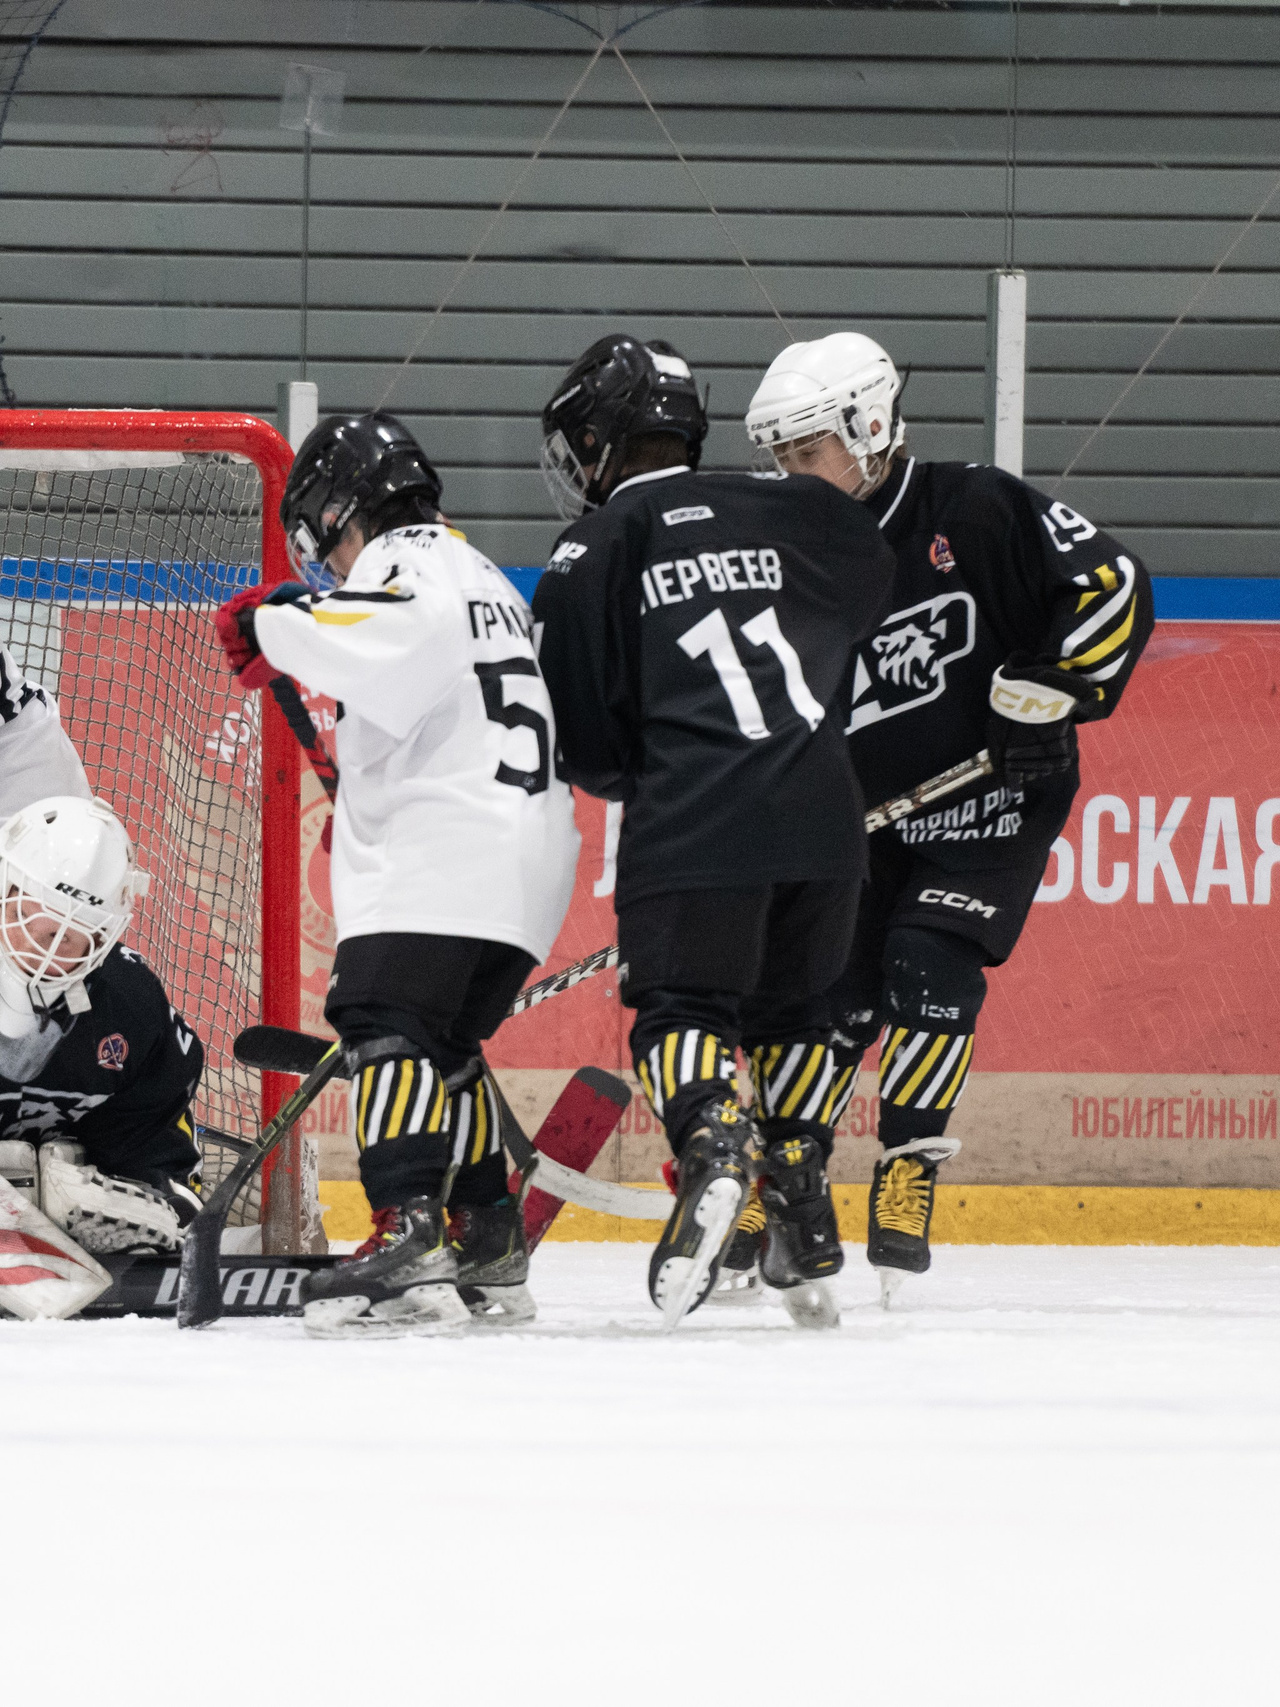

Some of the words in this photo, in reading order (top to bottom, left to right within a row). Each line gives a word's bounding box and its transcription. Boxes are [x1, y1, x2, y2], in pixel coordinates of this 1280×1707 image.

[675, 605, 824, 740] 11
[918, 888, 997, 919] CCM
[1071, 1089, 1278, 1140] ЮБИЛЕЙНЫЙ
